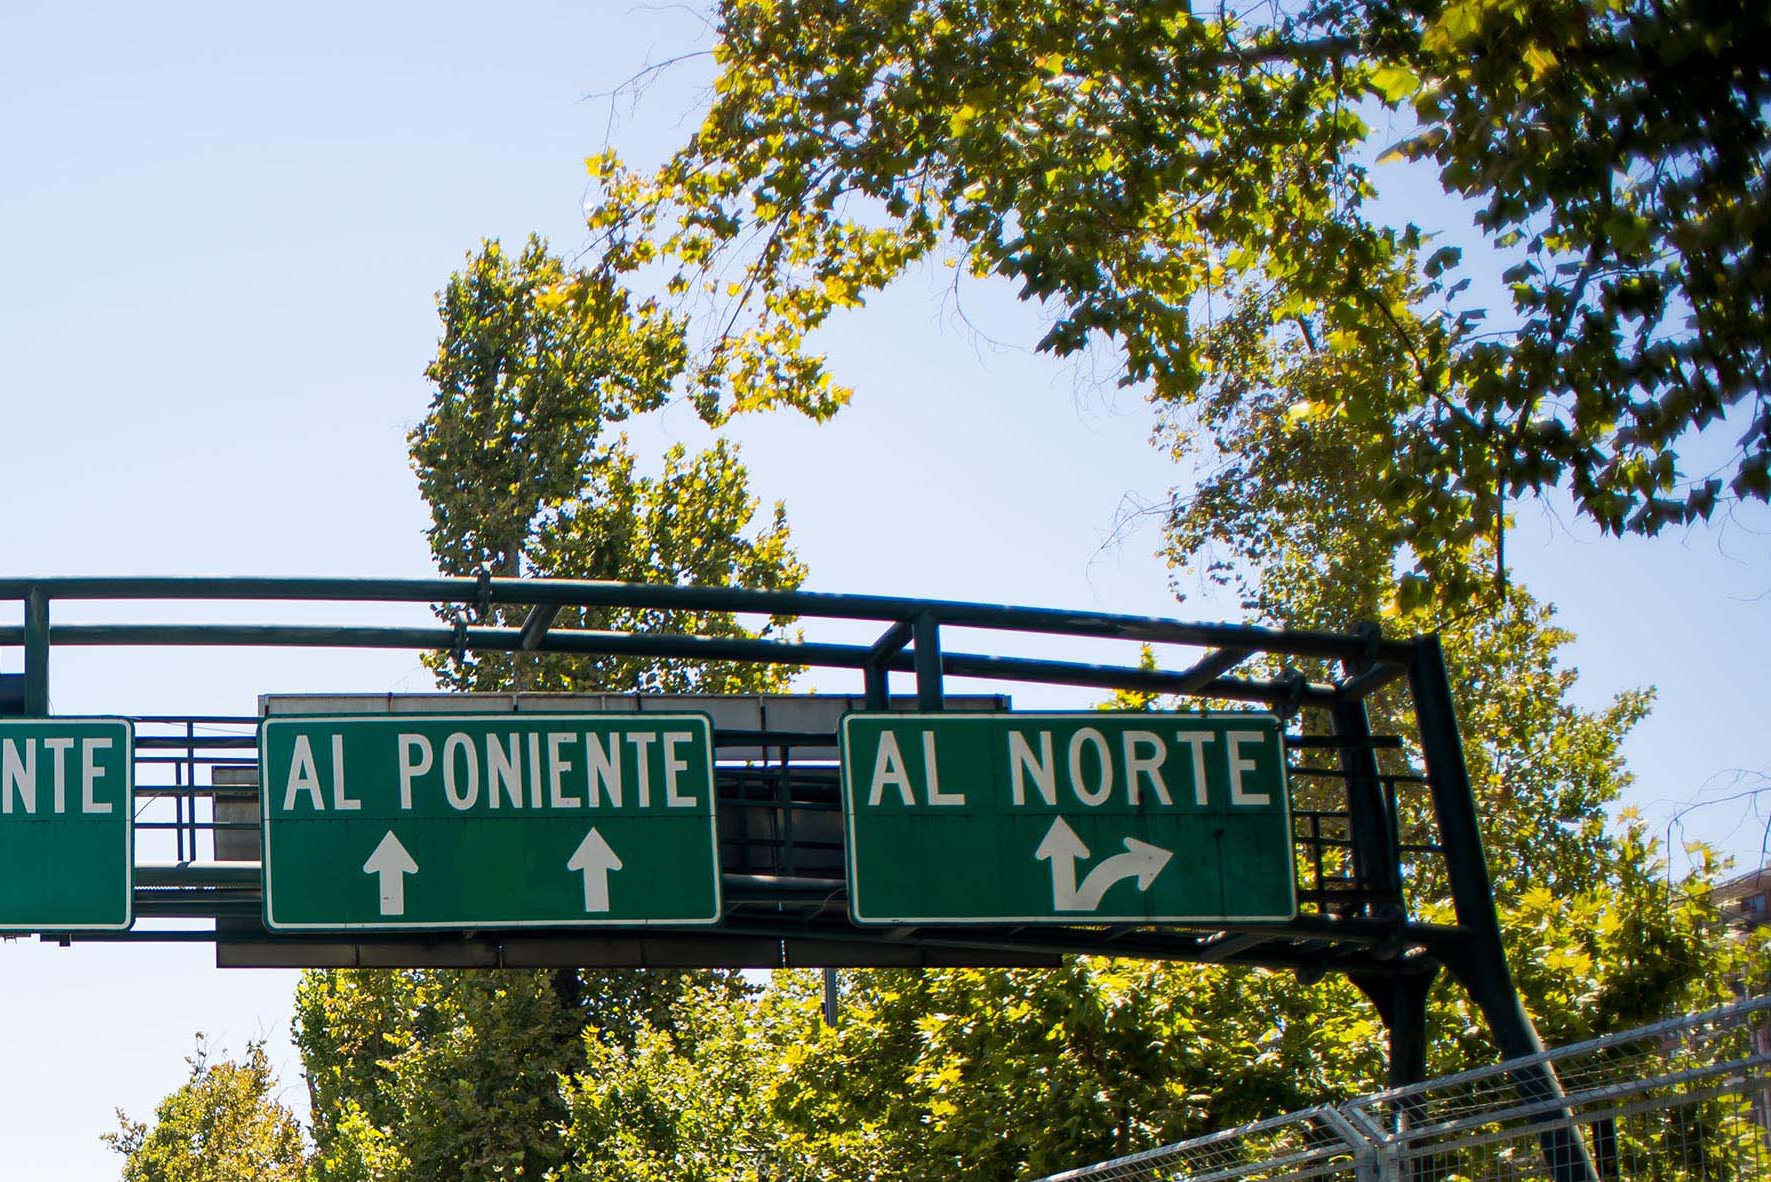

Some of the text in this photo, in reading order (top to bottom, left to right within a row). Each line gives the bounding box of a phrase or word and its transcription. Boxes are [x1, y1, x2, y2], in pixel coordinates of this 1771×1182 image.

[283, 731, 697, 811] AL PONIENTE
[868, 727, 1270, 806] AL NORTE
